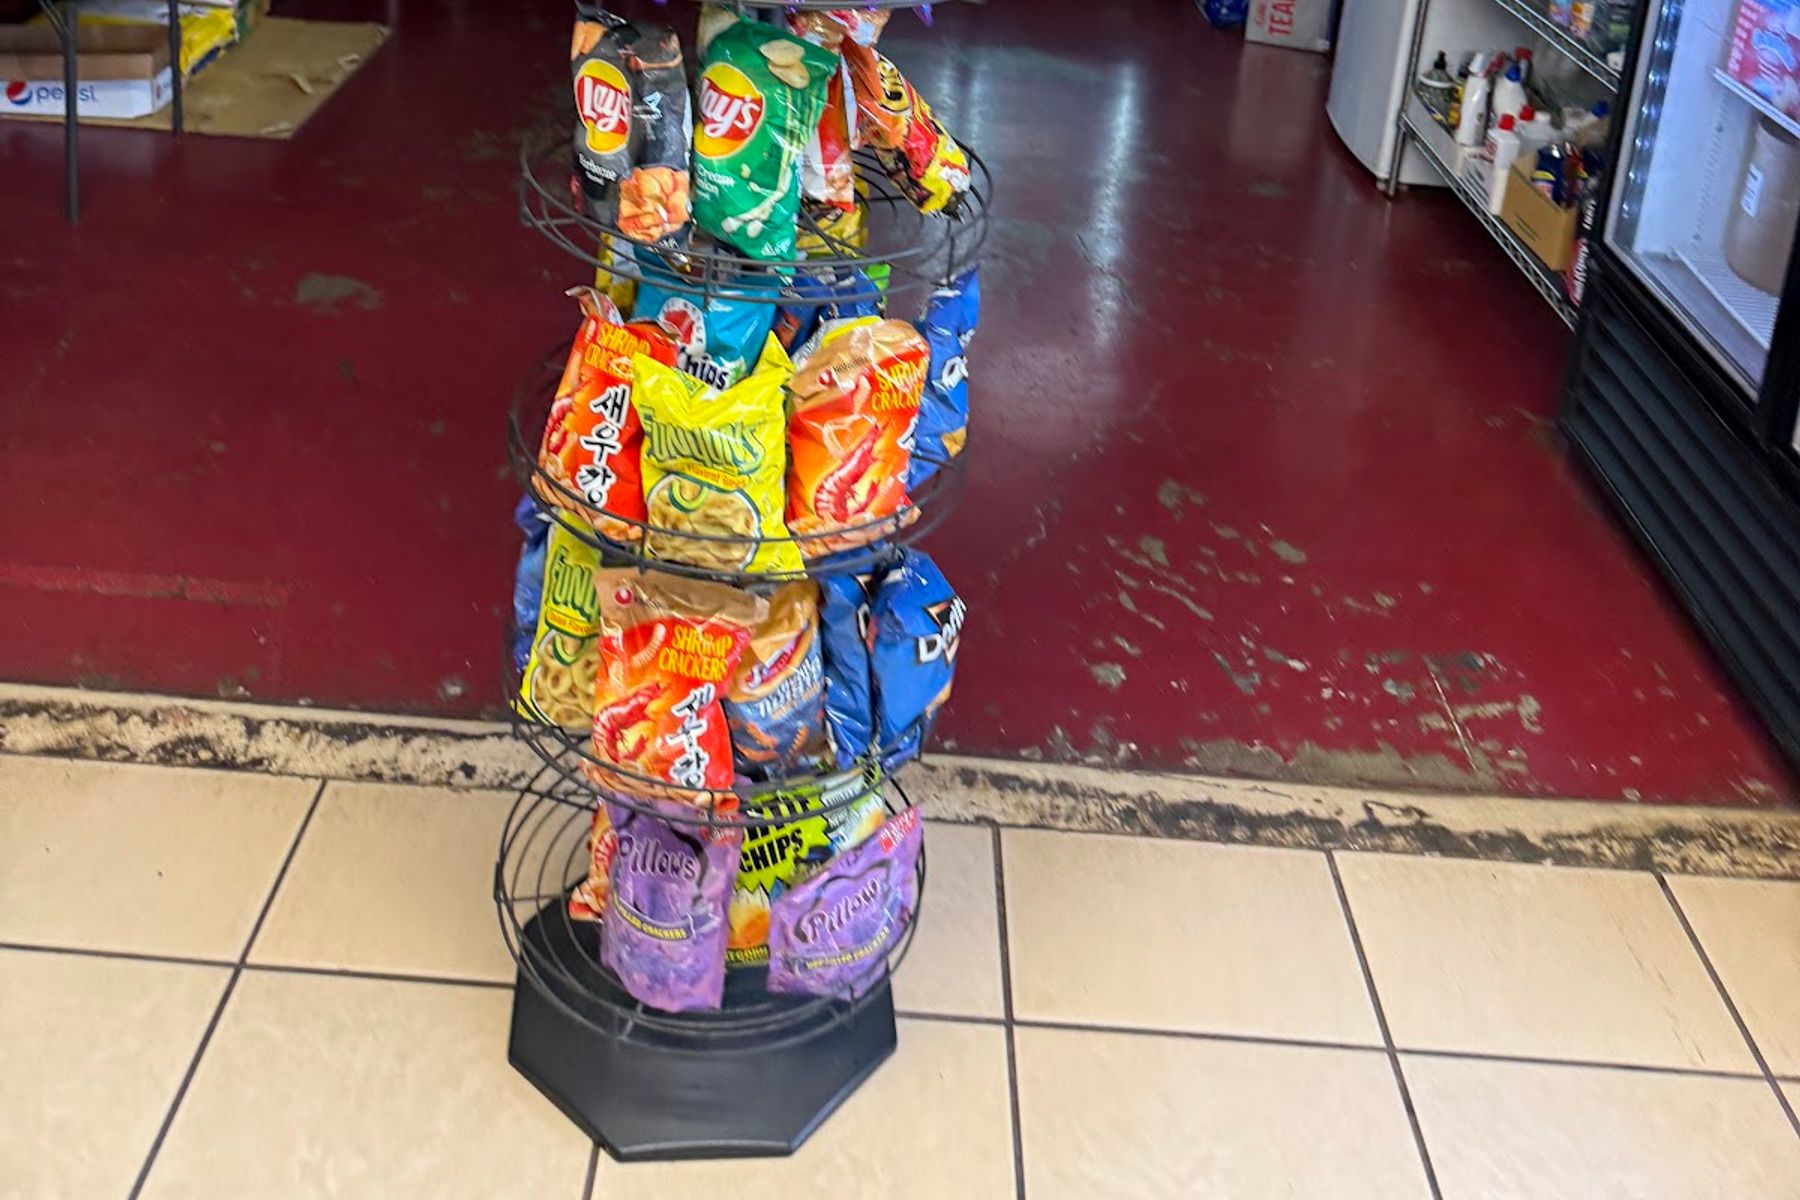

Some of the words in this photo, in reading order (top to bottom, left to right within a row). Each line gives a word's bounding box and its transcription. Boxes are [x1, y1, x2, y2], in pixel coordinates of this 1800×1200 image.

[673, 624, 733, 657] SHRIMP
[658, 647, 729, 682] CRACKERS
[618, 831, 698, 882] Pillows
[739, 827, 804, 874] CHIPS
